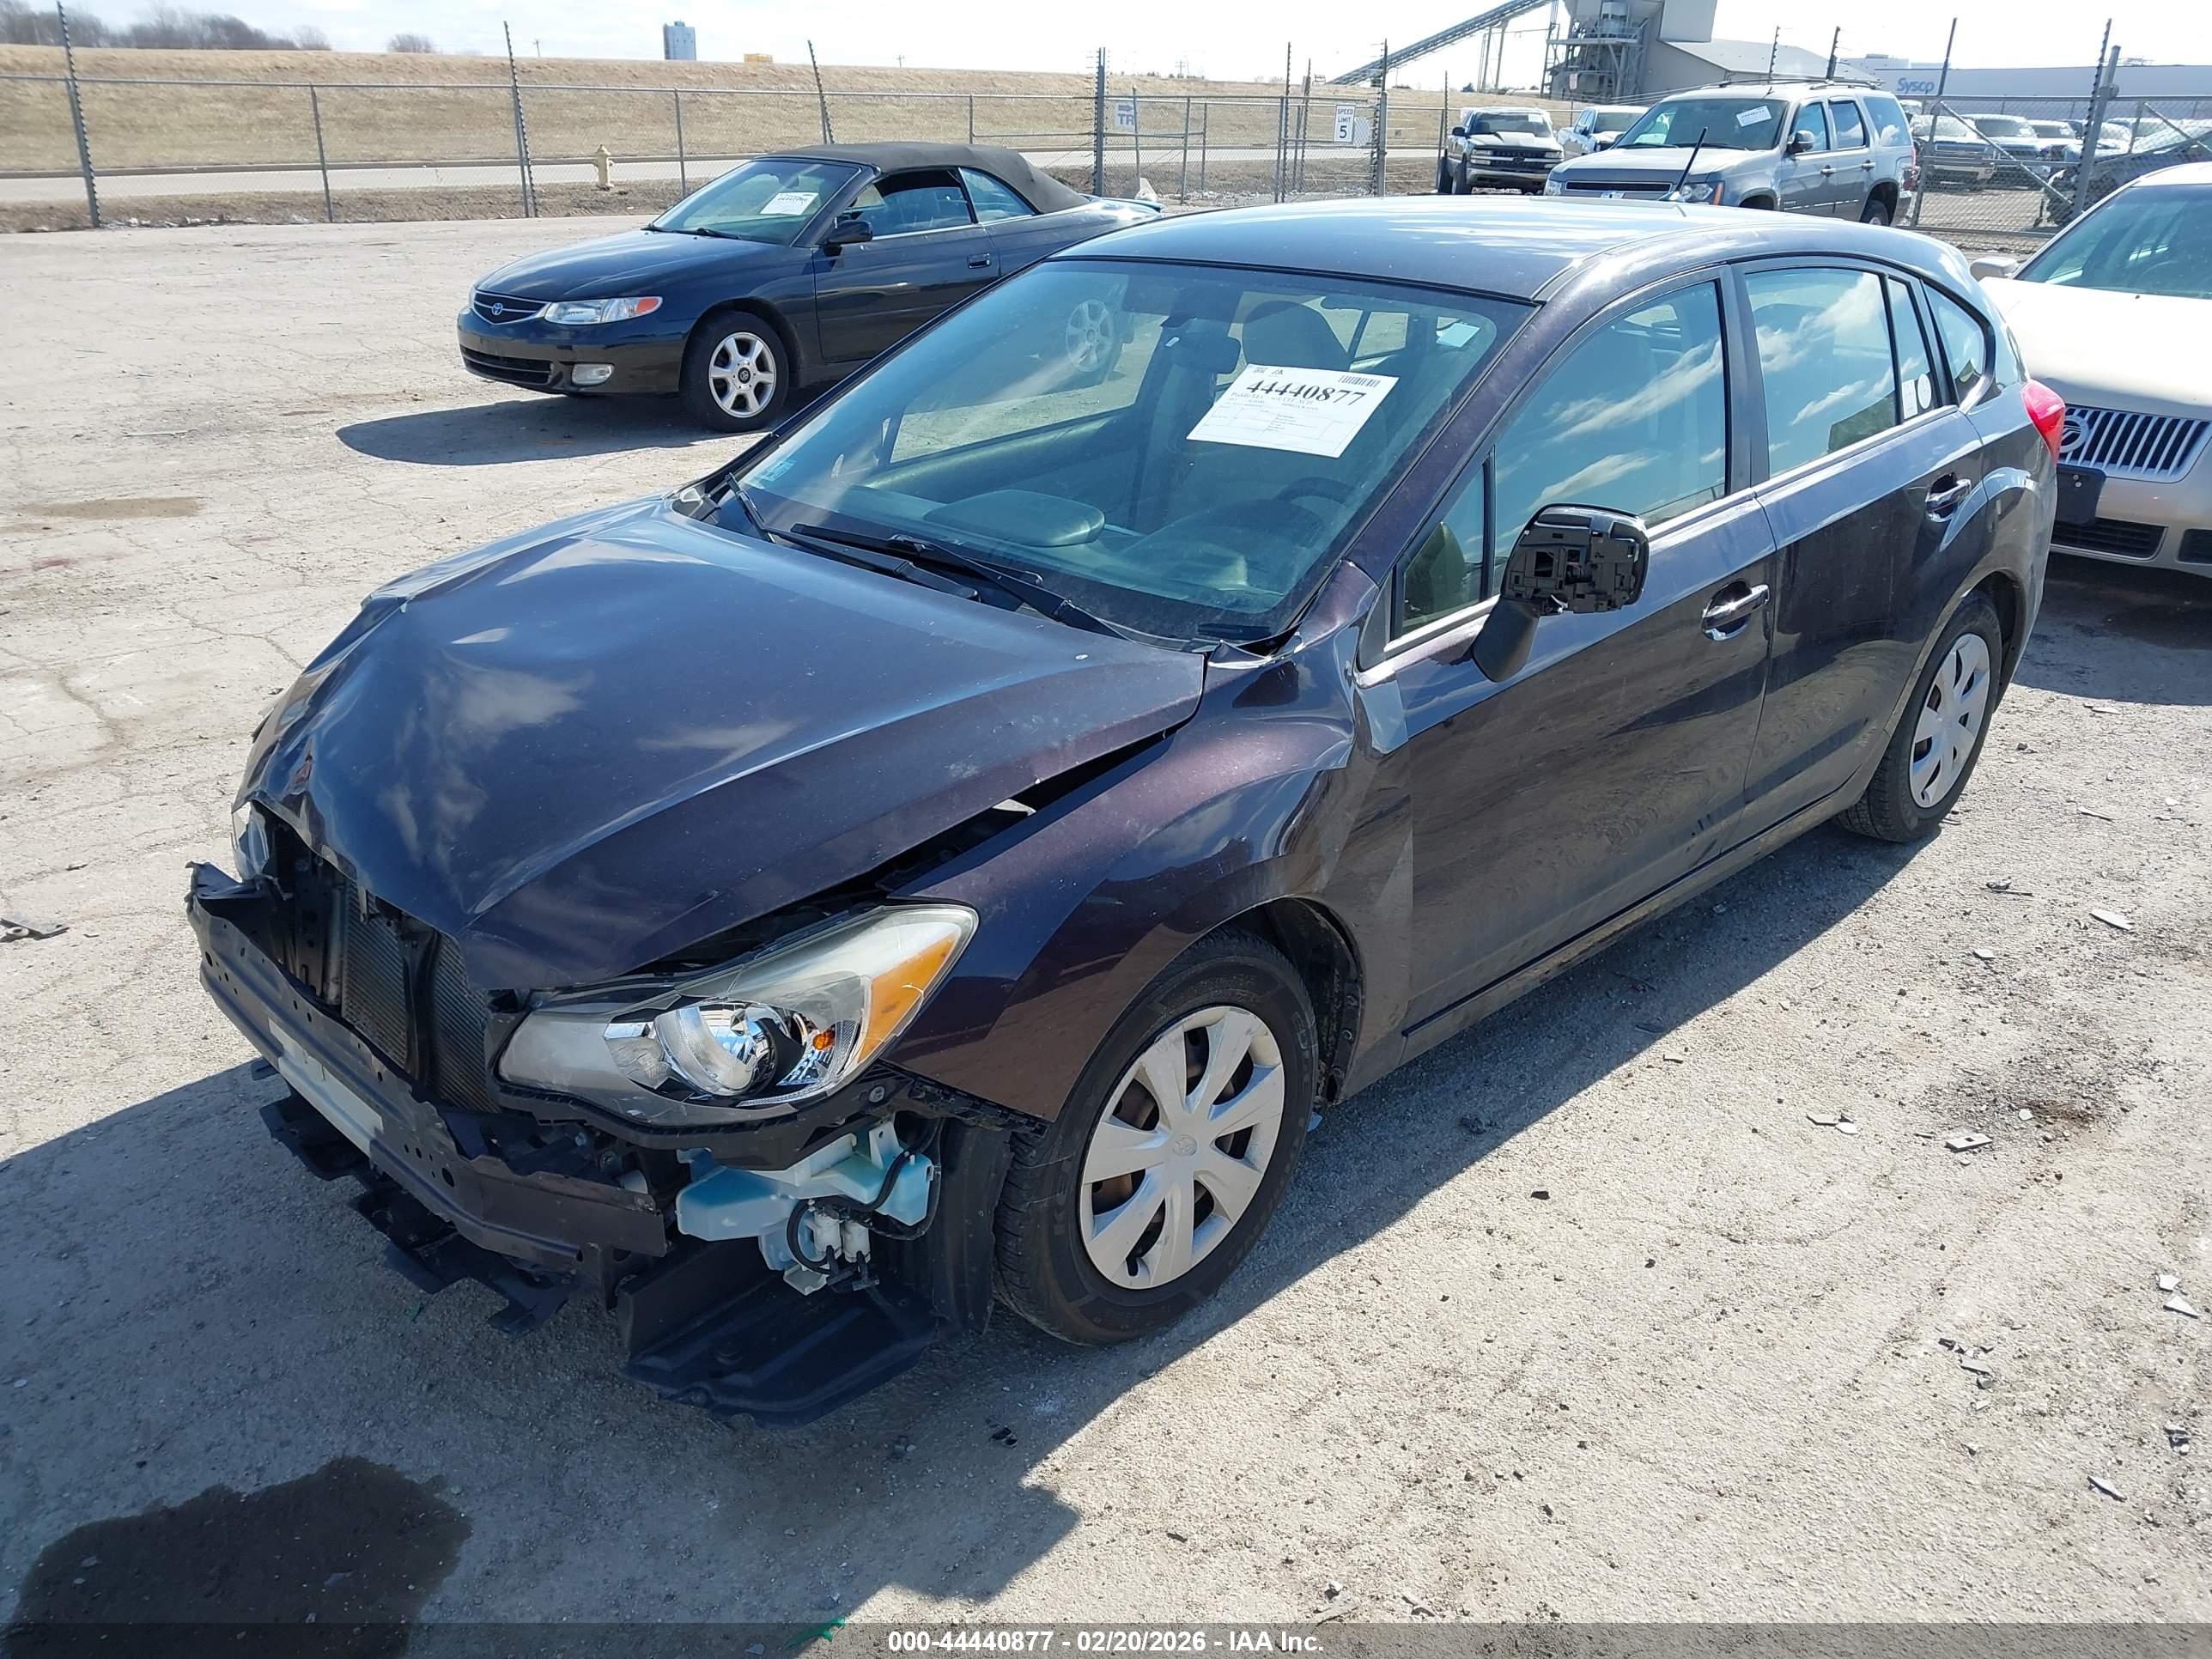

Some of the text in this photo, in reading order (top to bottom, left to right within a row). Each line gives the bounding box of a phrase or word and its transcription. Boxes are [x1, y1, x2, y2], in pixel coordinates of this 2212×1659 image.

[1897, 77, 1936, 94] Sysco
[1339, 125, 1347, 139] 5
[1247, 380, 1367, 406] 44440877
